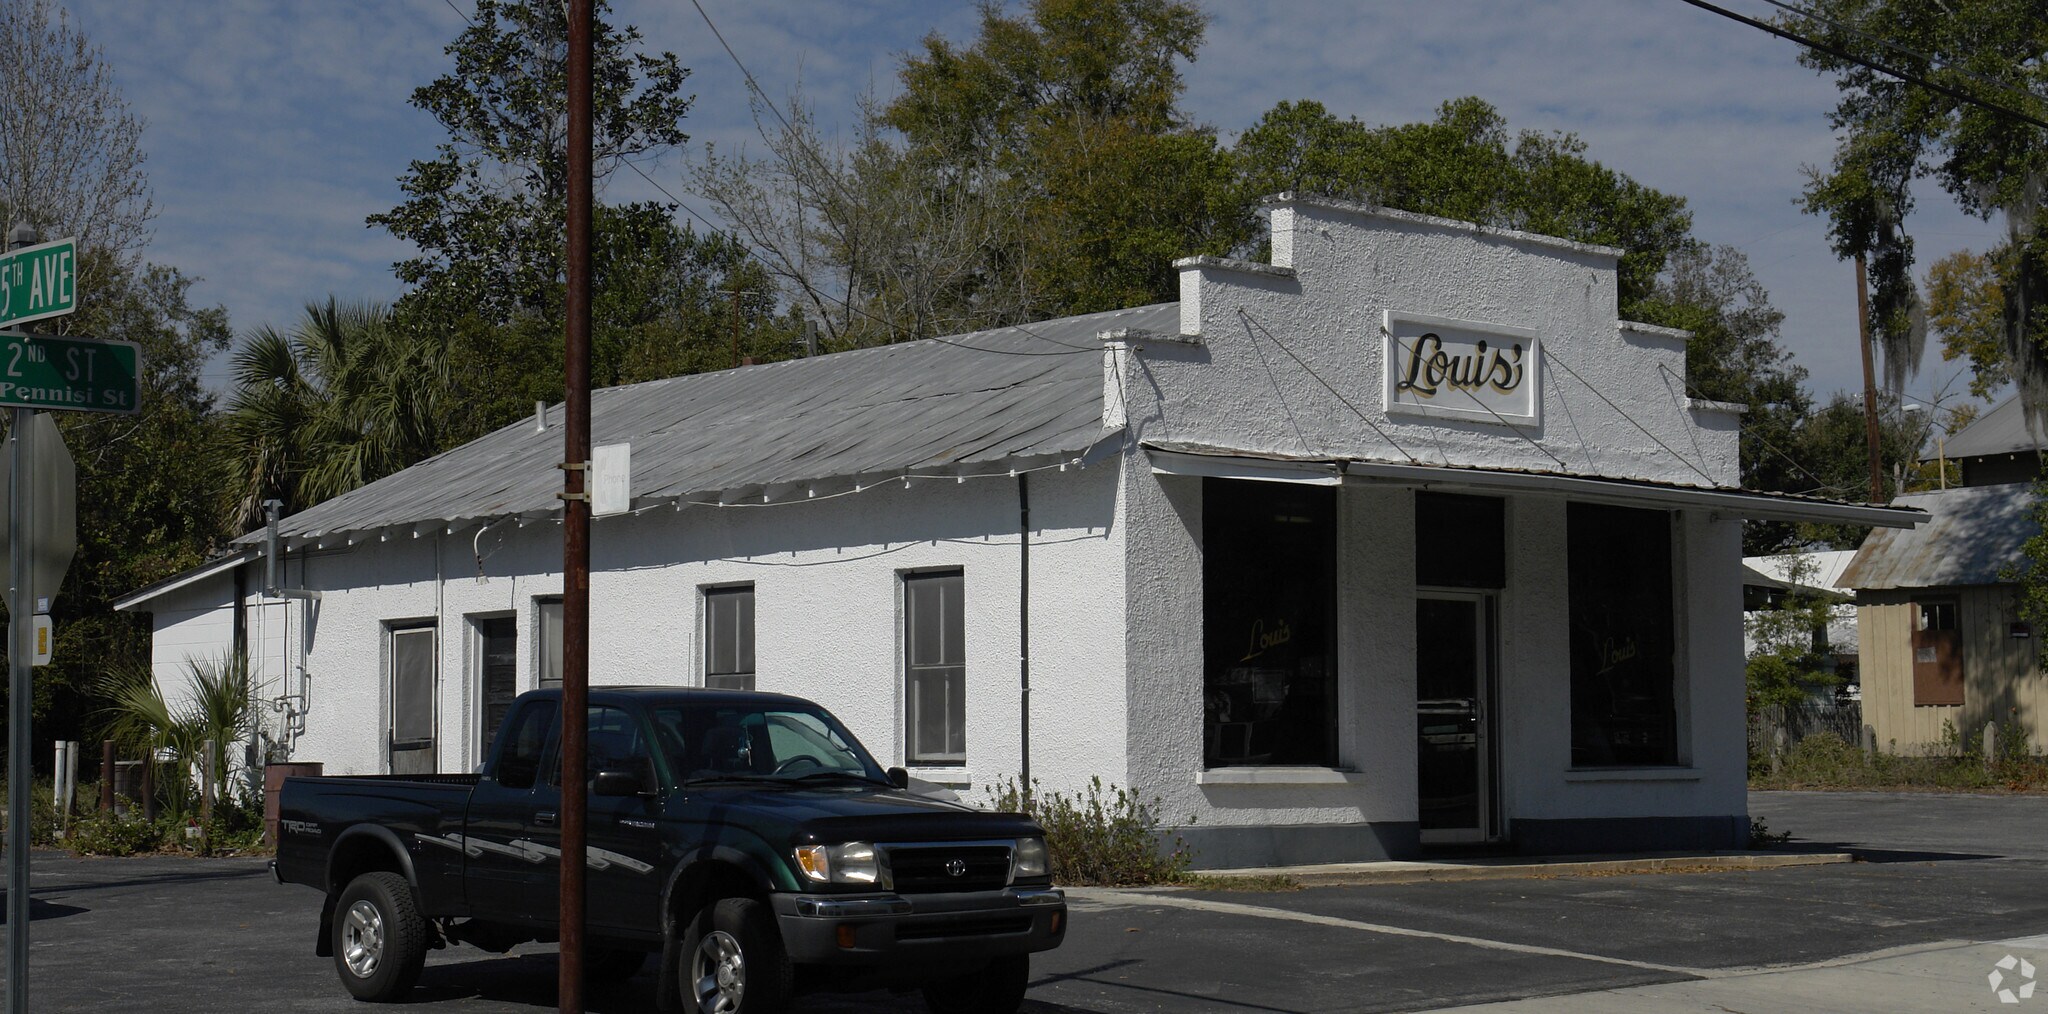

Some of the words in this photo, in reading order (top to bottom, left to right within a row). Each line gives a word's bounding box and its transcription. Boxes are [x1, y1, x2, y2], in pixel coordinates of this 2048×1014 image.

[1, 261, 23, 317] 5TH
[29, 250, 71, 310] AVE
[7, 342, 46, 377] 2ND
[66, 346, 96, 383] ST
[0, 382, 93, 404] Pennisi
[103, 388, 127, 406] St
[281, 819, 305, 834] TRD
